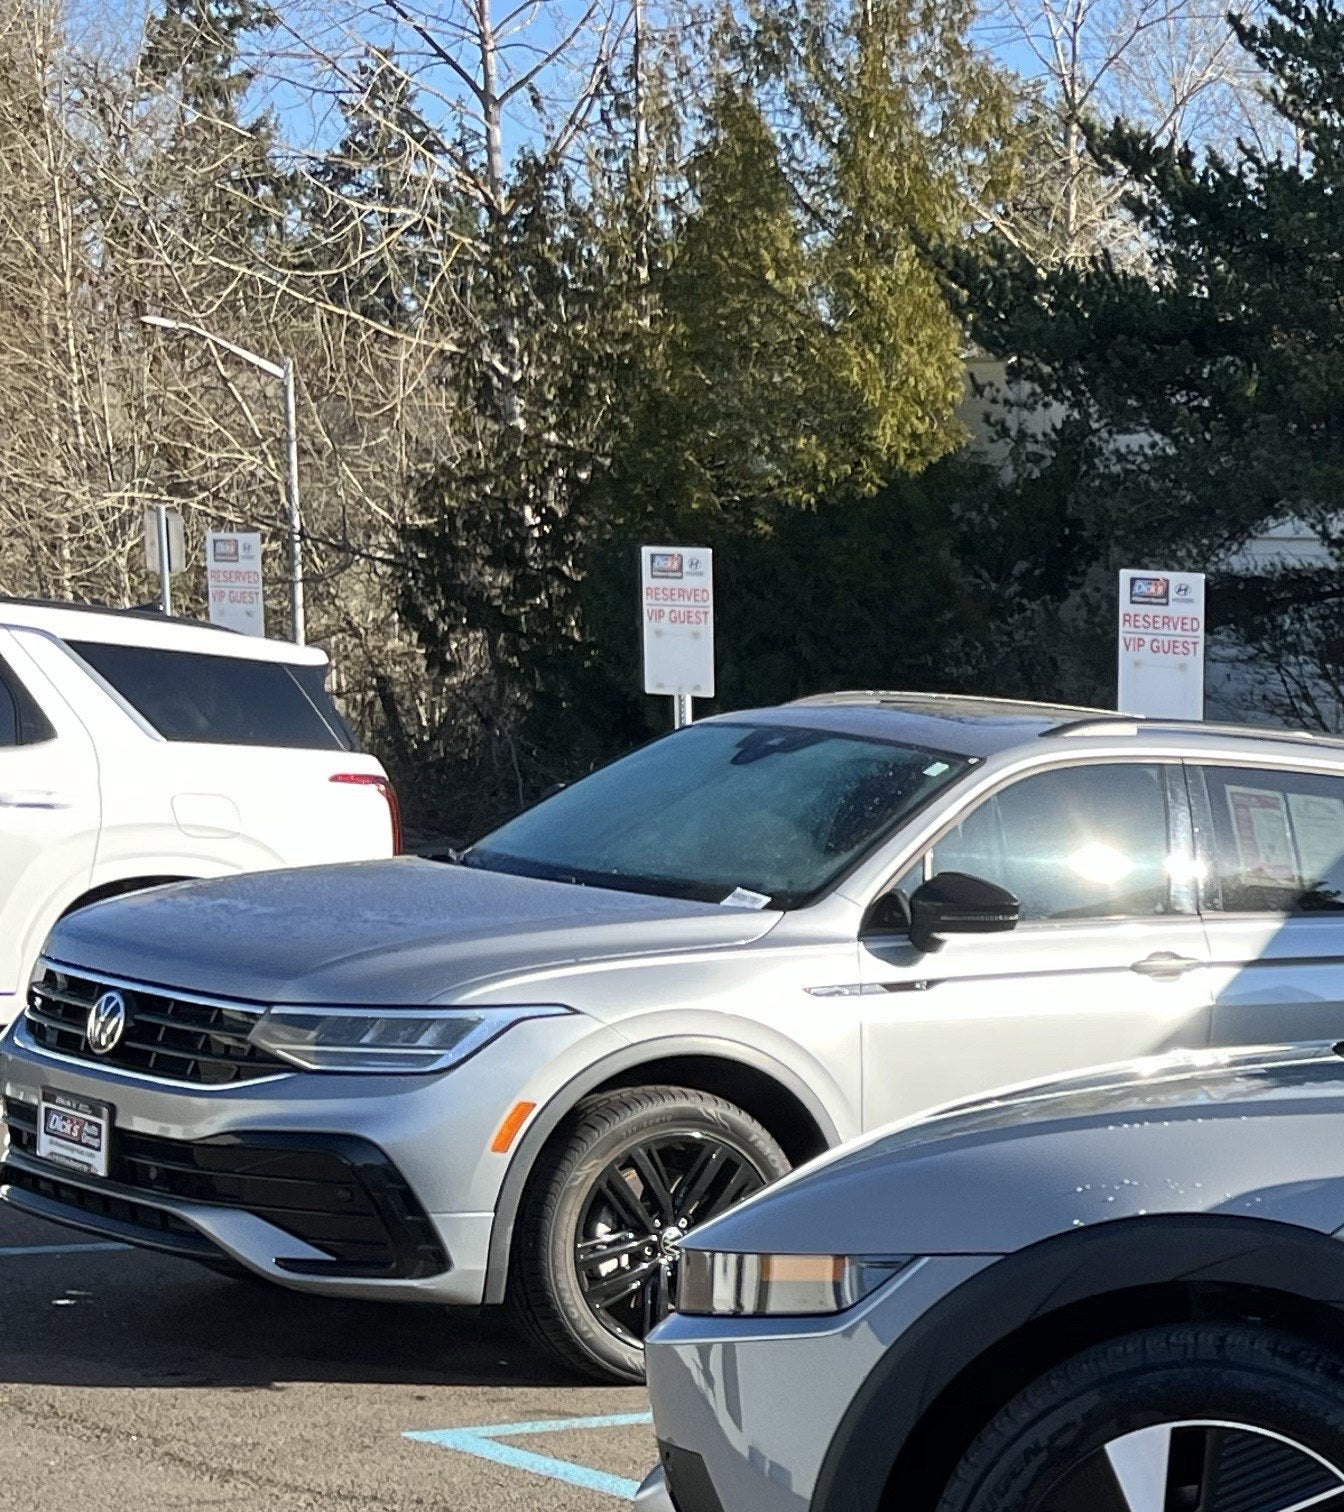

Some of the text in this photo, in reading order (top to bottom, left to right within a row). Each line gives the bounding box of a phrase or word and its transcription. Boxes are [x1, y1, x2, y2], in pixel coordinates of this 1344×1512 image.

[209, 569, 261, 584] RESERVED
[211, 589, 261, 605] VIP GUEST
[645, 586, 710, 603] RESERVED
[646, 608, 710, 625] VIP GUEST
[1122, 612, 1201, 633] RESERVED
[1122, 636, 1200, 657] VIP GUEST
